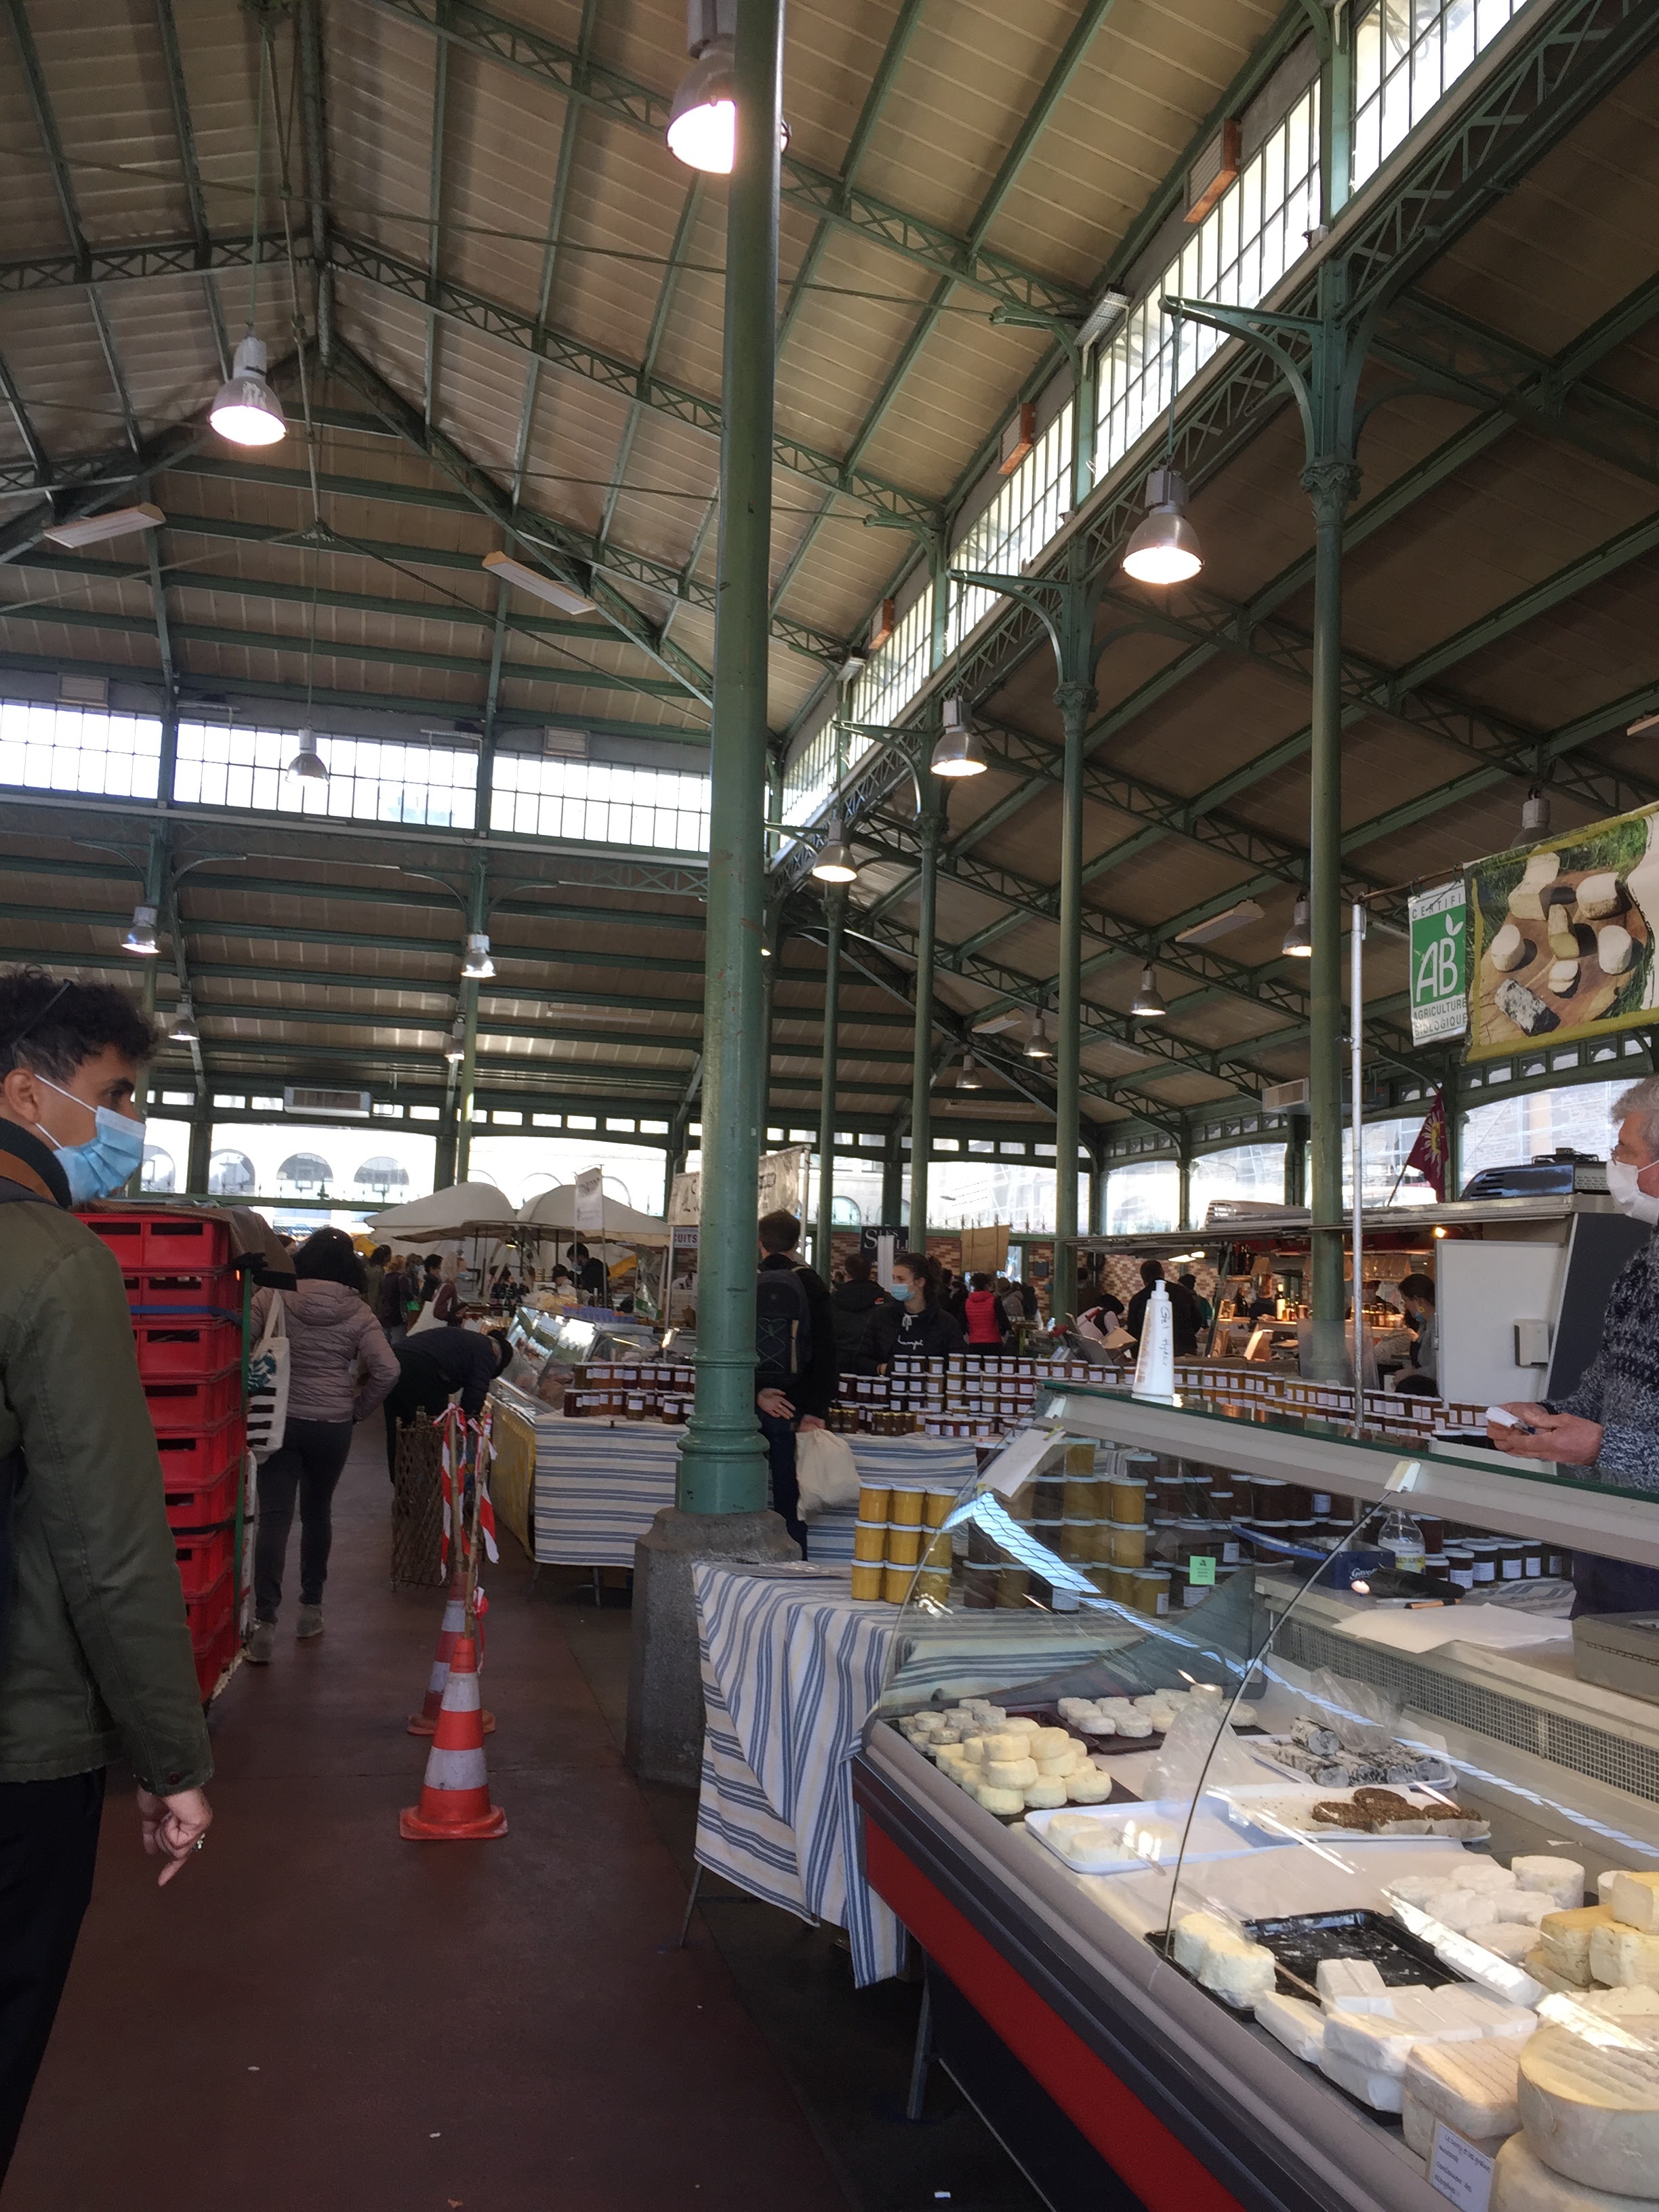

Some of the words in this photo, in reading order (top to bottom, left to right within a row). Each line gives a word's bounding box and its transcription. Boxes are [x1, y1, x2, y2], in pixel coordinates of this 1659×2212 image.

[1416, 938, 1458, 1002] AB
[1413, 998, 1467, 1021] AGRICULTURE
[1414, 1013, 1467, 1037] BIOLOGIQUE
